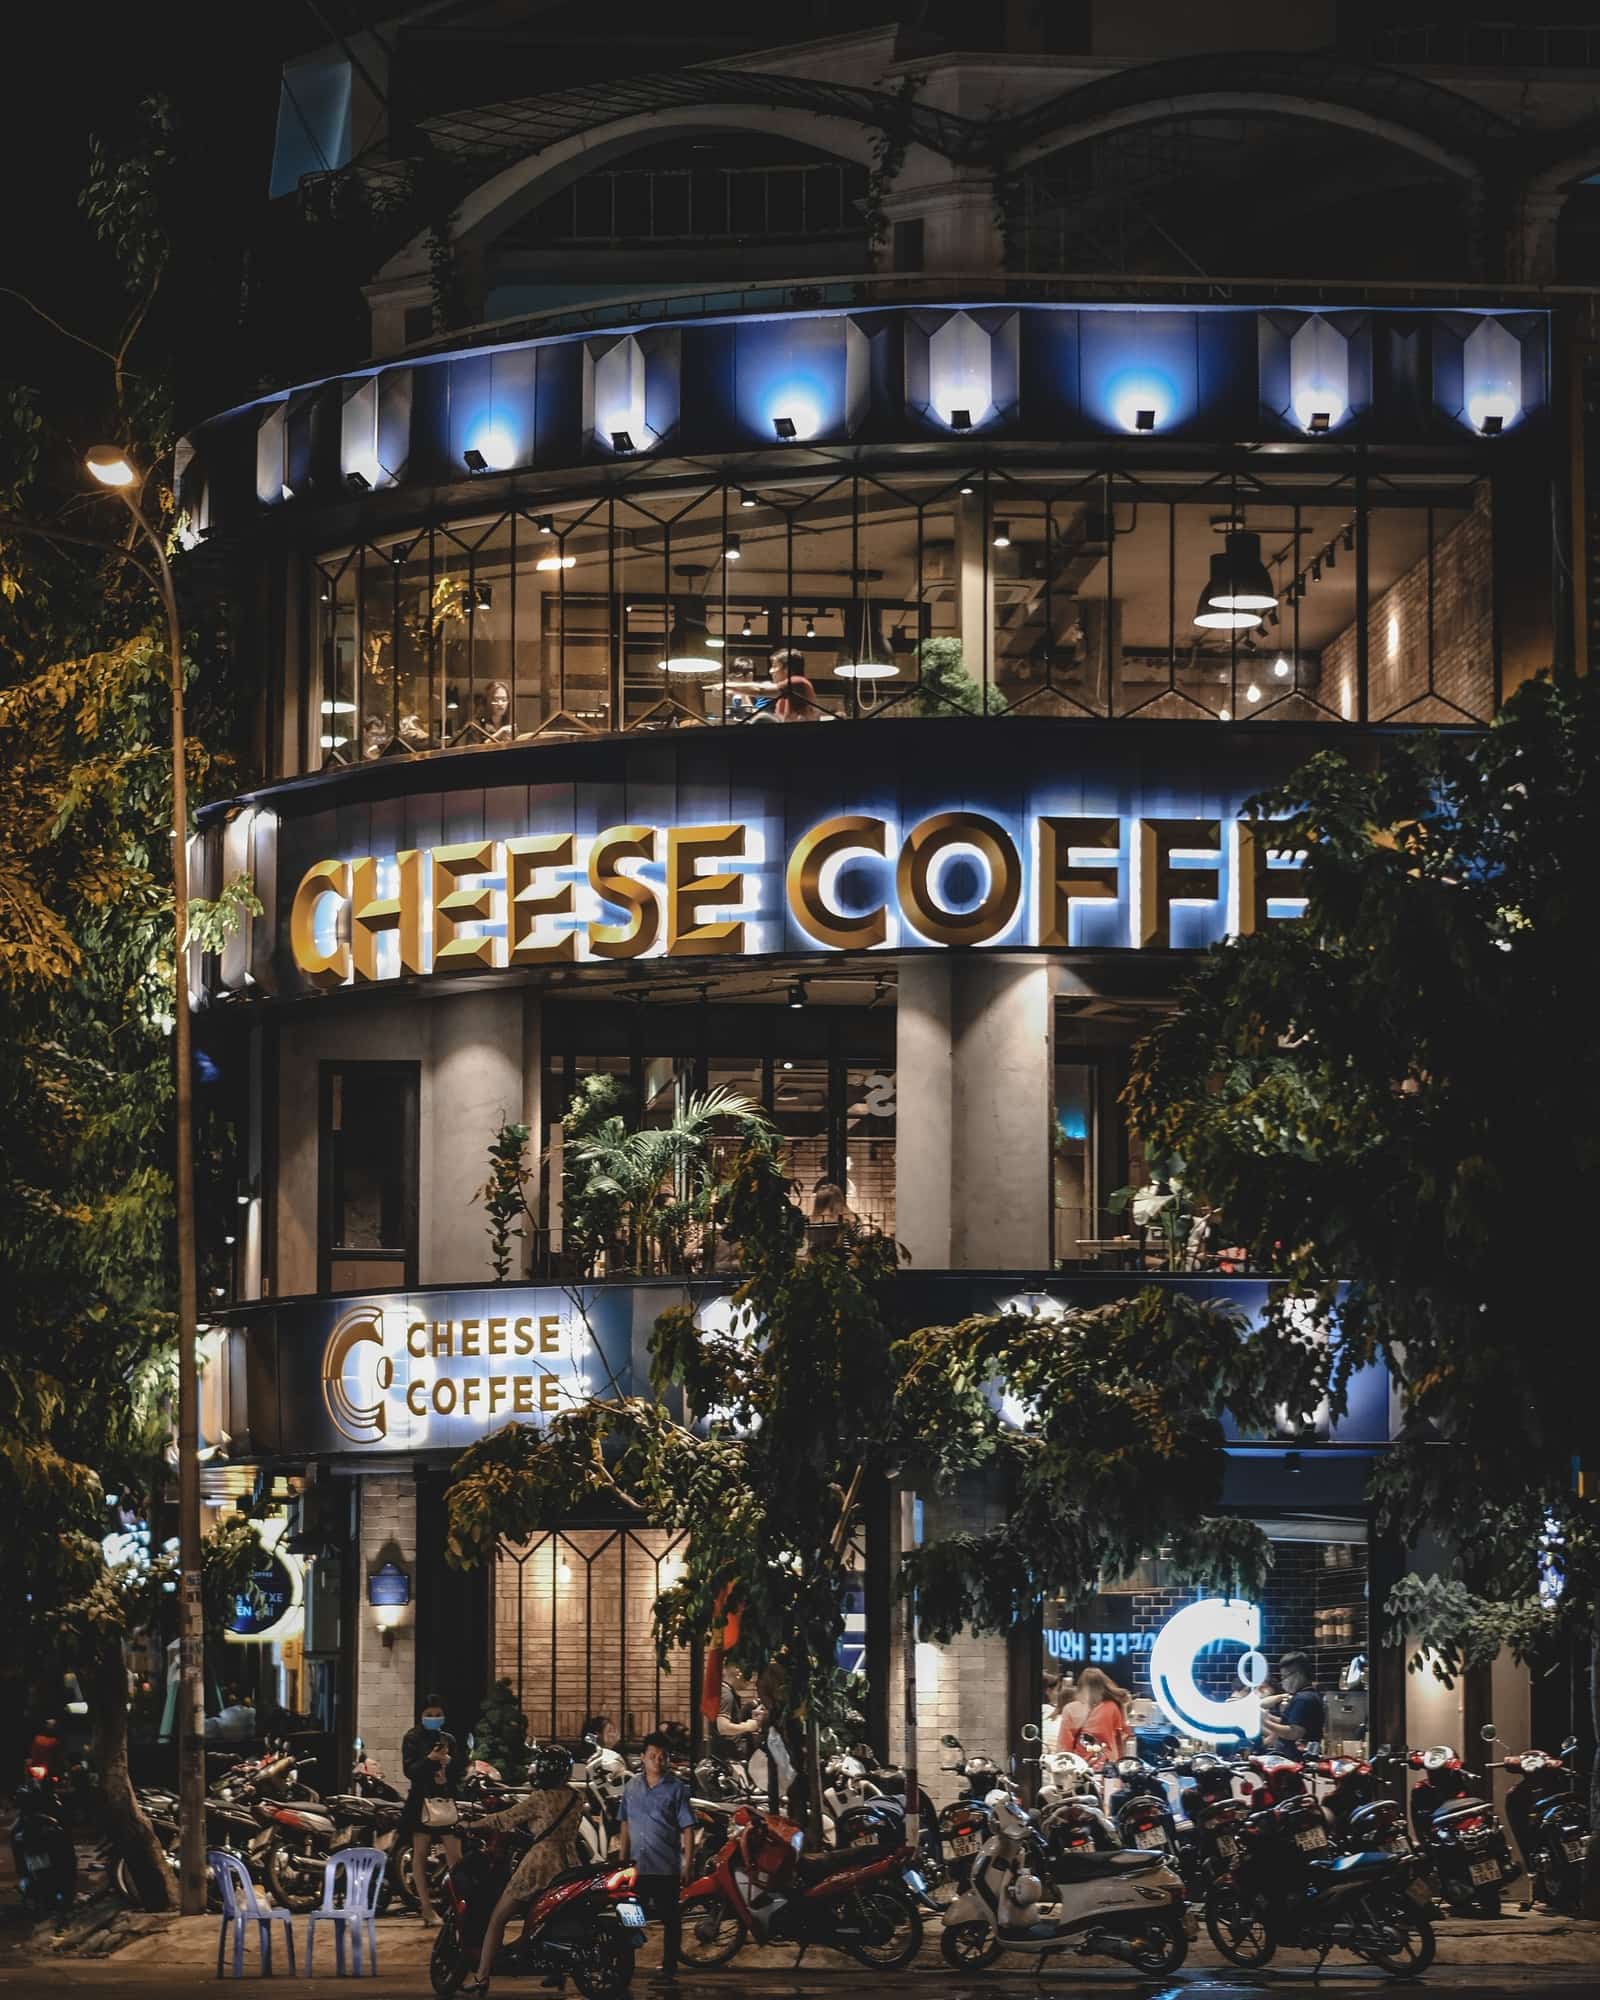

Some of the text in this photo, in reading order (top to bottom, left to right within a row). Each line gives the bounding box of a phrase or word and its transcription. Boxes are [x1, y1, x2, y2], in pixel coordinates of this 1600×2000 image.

[291, 811, 1310, 986] CHEESE COFFE
[407, 1315, 560, 1358] CHEESE
[406, 1374, 560, 1416] COFFEE
